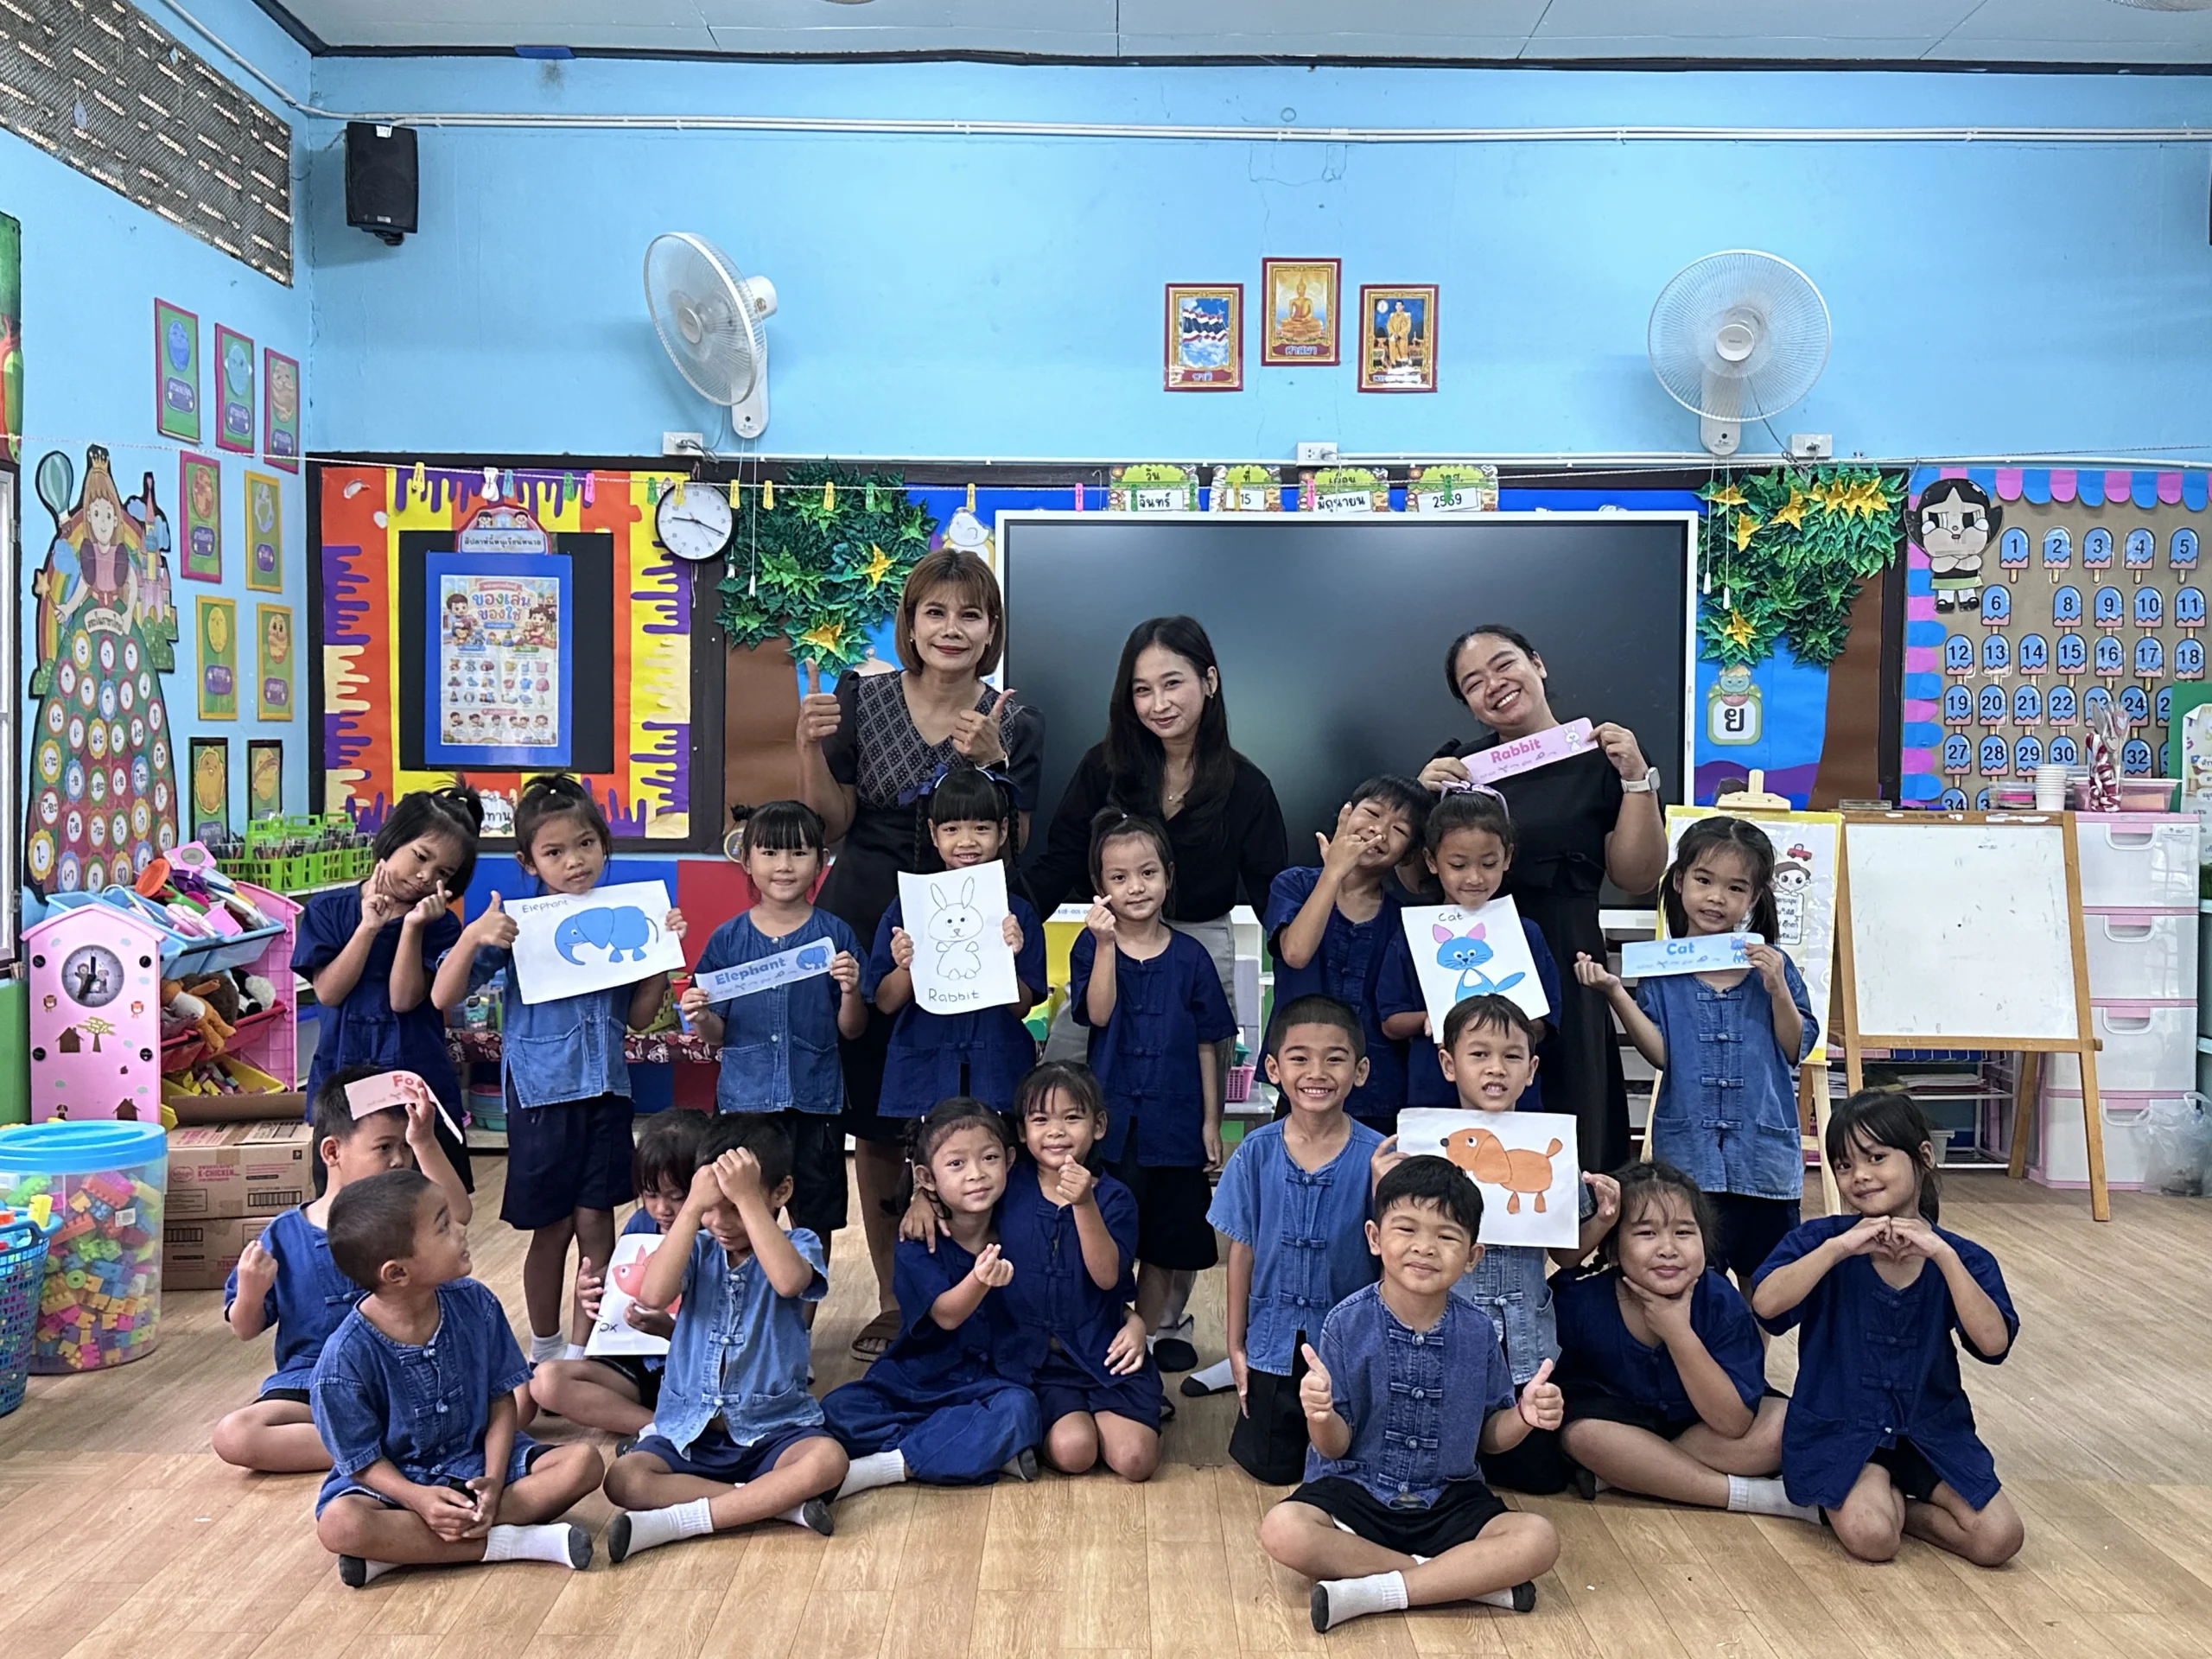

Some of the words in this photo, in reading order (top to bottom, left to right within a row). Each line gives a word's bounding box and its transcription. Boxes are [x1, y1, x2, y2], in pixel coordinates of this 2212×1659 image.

[1286, 346, 1317, 356] ศาสนา
[1192, 372, 1212, 382] ชาติ
[1146, 468, 1160, 481] วัน
[1243, 468, 1251, 481] ที่
[1139, 492, 1172, 508] จันทร์
[1241, 493, 1251, 505] 15
[1317, 495, 1365, 512] มิถุนายน
[1433, 493, 1462, 508] 2569
[2012, 539, 2017, 552] 1
[2053, 539, 2062, 553] 2
[2094, 539, 2102, 553] 3
[2136, 540, 2144, 553] 4
[2181, 540, 2189, 553] 5
[472, 591, 531, 607] ของเล่น
[1992, 596, 2000, 610] 6
[2064, 597, 2072, 611] 8
[2105, 598, 2113, 612] 9
[2140, 598, 2158, 612] 10
[2180, 599, 2196, 612] 11
[478, 606, 522, 621] ของใช้
[1949, 645, 1967, 659] 12
[1986, 645, 2005, 659] 13
[2024, 645, 2042, 659] 14
[2062, 645, 2081, 658] 15
[2099, 647, 2118, 661] 16
[2139, 648, 2158, 662] 17
[2180, 650, 2199, 664] 18
[1948, 696, 1967, 709] 19
[1982, 696, 2001, 710] 20
[2018, 696, 2037, 710] 21
[2053, 696, 2072, 710] 22
[2126, 697, 2145, 711] 24
[2160, 697, 2170, 712] 2
[1724, 709, 1745, 732] ย
[1490, 739, 1541, 764] Rabbit
[1949, 746, 1968, 760] 27
[1984, 746, 2003, 760] 28
[2019, 747, 2038, 760] 29
[2054, 747, 2073, 761] 30
[2127, 750, 2147, 764] 32
[1945, 798, 1964, 810] 34
[1980, 798, 1990, 810] 3
[484, 810, 511, 822] ทาน
[522, 898, 569, 914] Elephant
[1438, 912, 1463, 923] Cat
[1666, 942, 1694, 956] Cat
[715, 957, 787, 985] Elephant
[928, 988, 980, 1003] Rabbit
[392, 1074, 415, 1088] Fo
